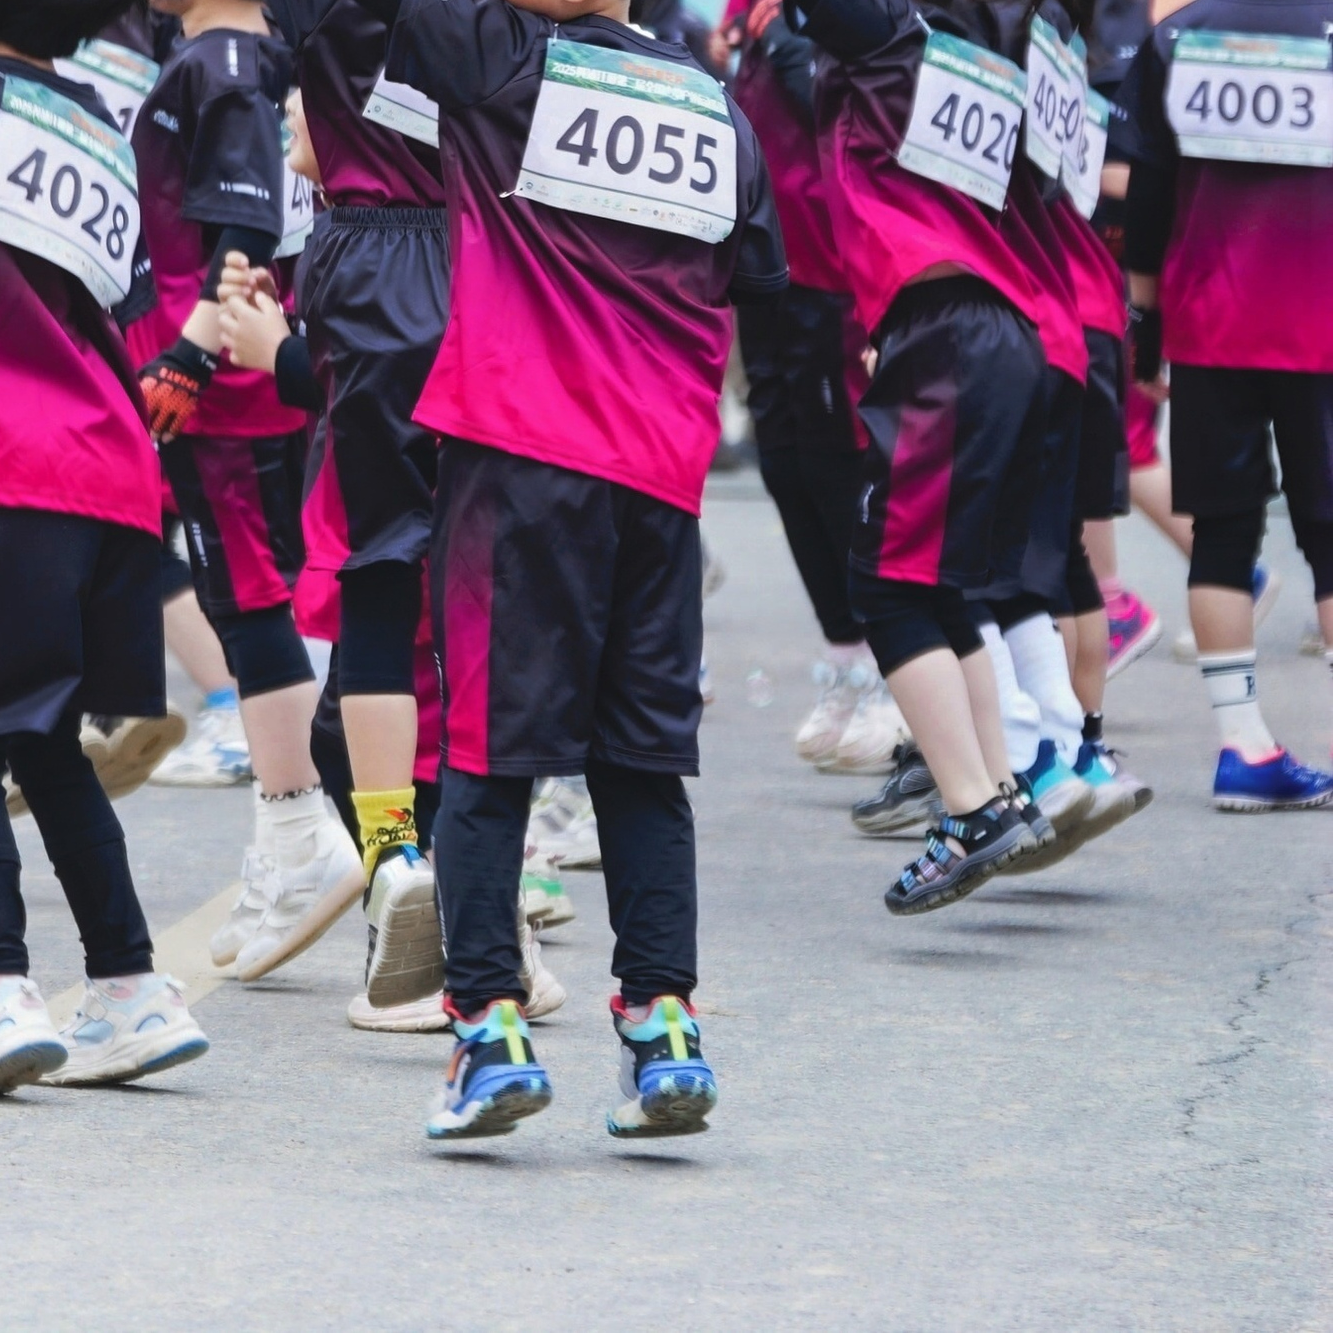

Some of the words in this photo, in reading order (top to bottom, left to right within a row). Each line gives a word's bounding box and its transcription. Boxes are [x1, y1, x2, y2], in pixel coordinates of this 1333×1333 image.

[1185, 79, 1315, 130] 4003
[555, 107, 718, 195] 4055
[7, 148, 129, 261] 4028
